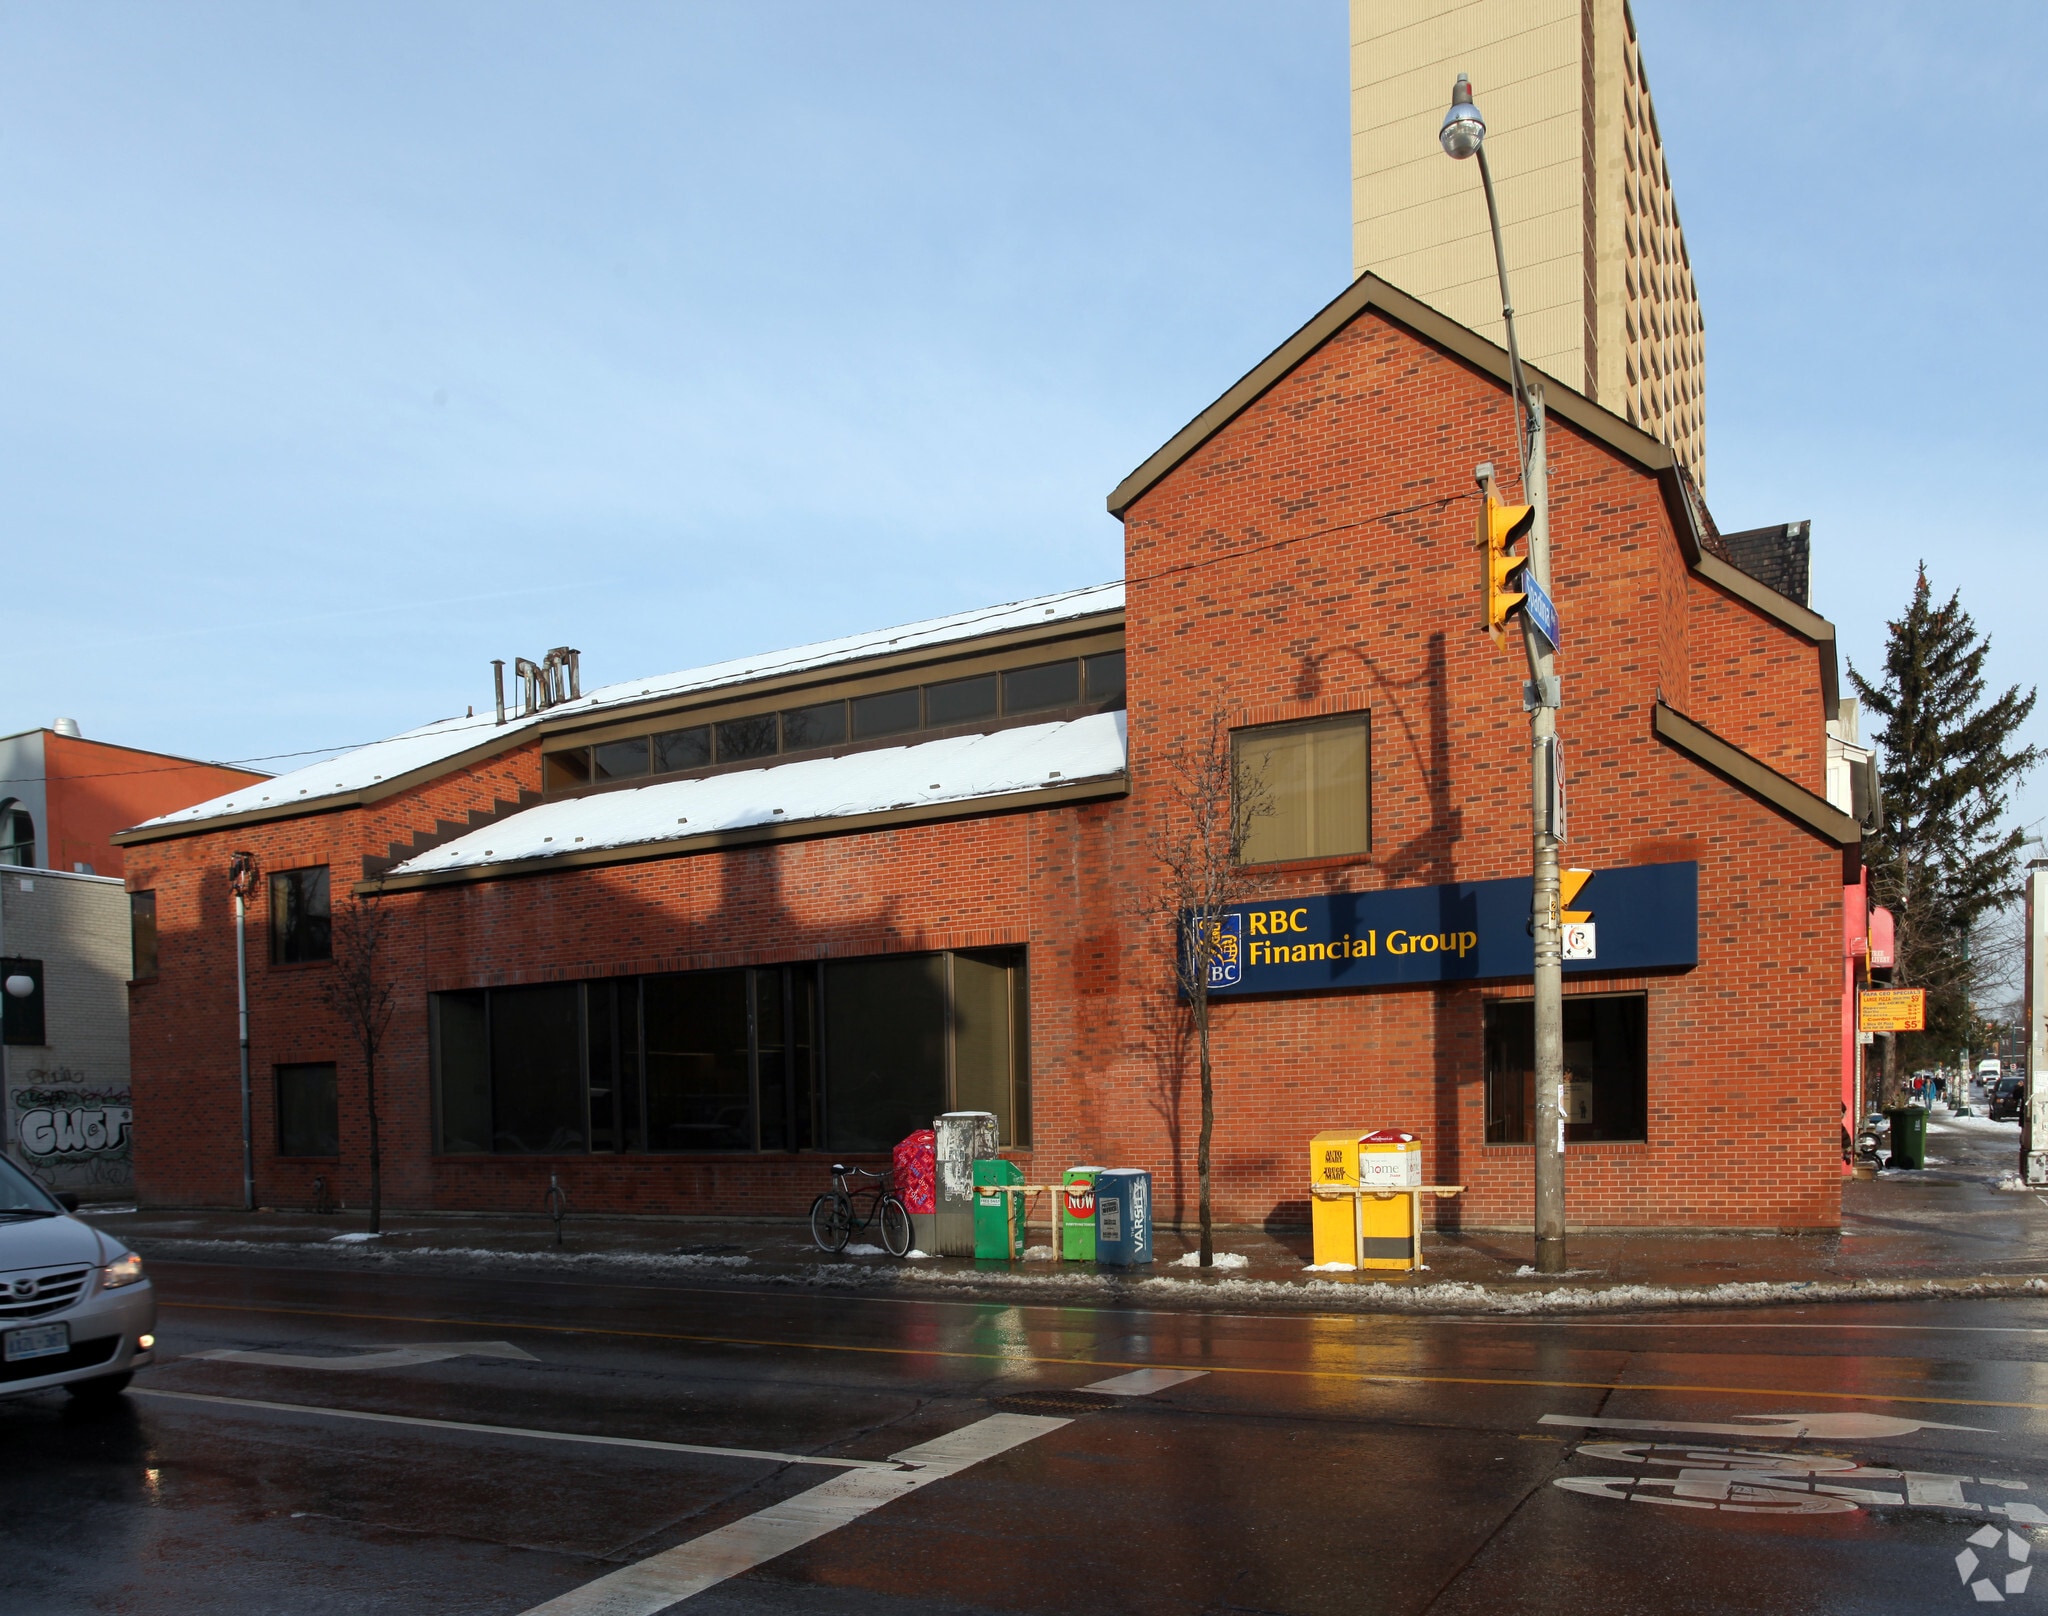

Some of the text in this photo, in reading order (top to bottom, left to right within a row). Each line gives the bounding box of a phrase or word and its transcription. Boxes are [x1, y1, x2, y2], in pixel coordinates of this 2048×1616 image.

[1249, 908, 1307, 935] RBC
[1249, 928, 1477, 966] Financial Group
[1207, 965, 1236, 982] BC
[1068, 1194, 1094, 1209] NOW
[1134, 1182, 1144, 1253] VARSITY
